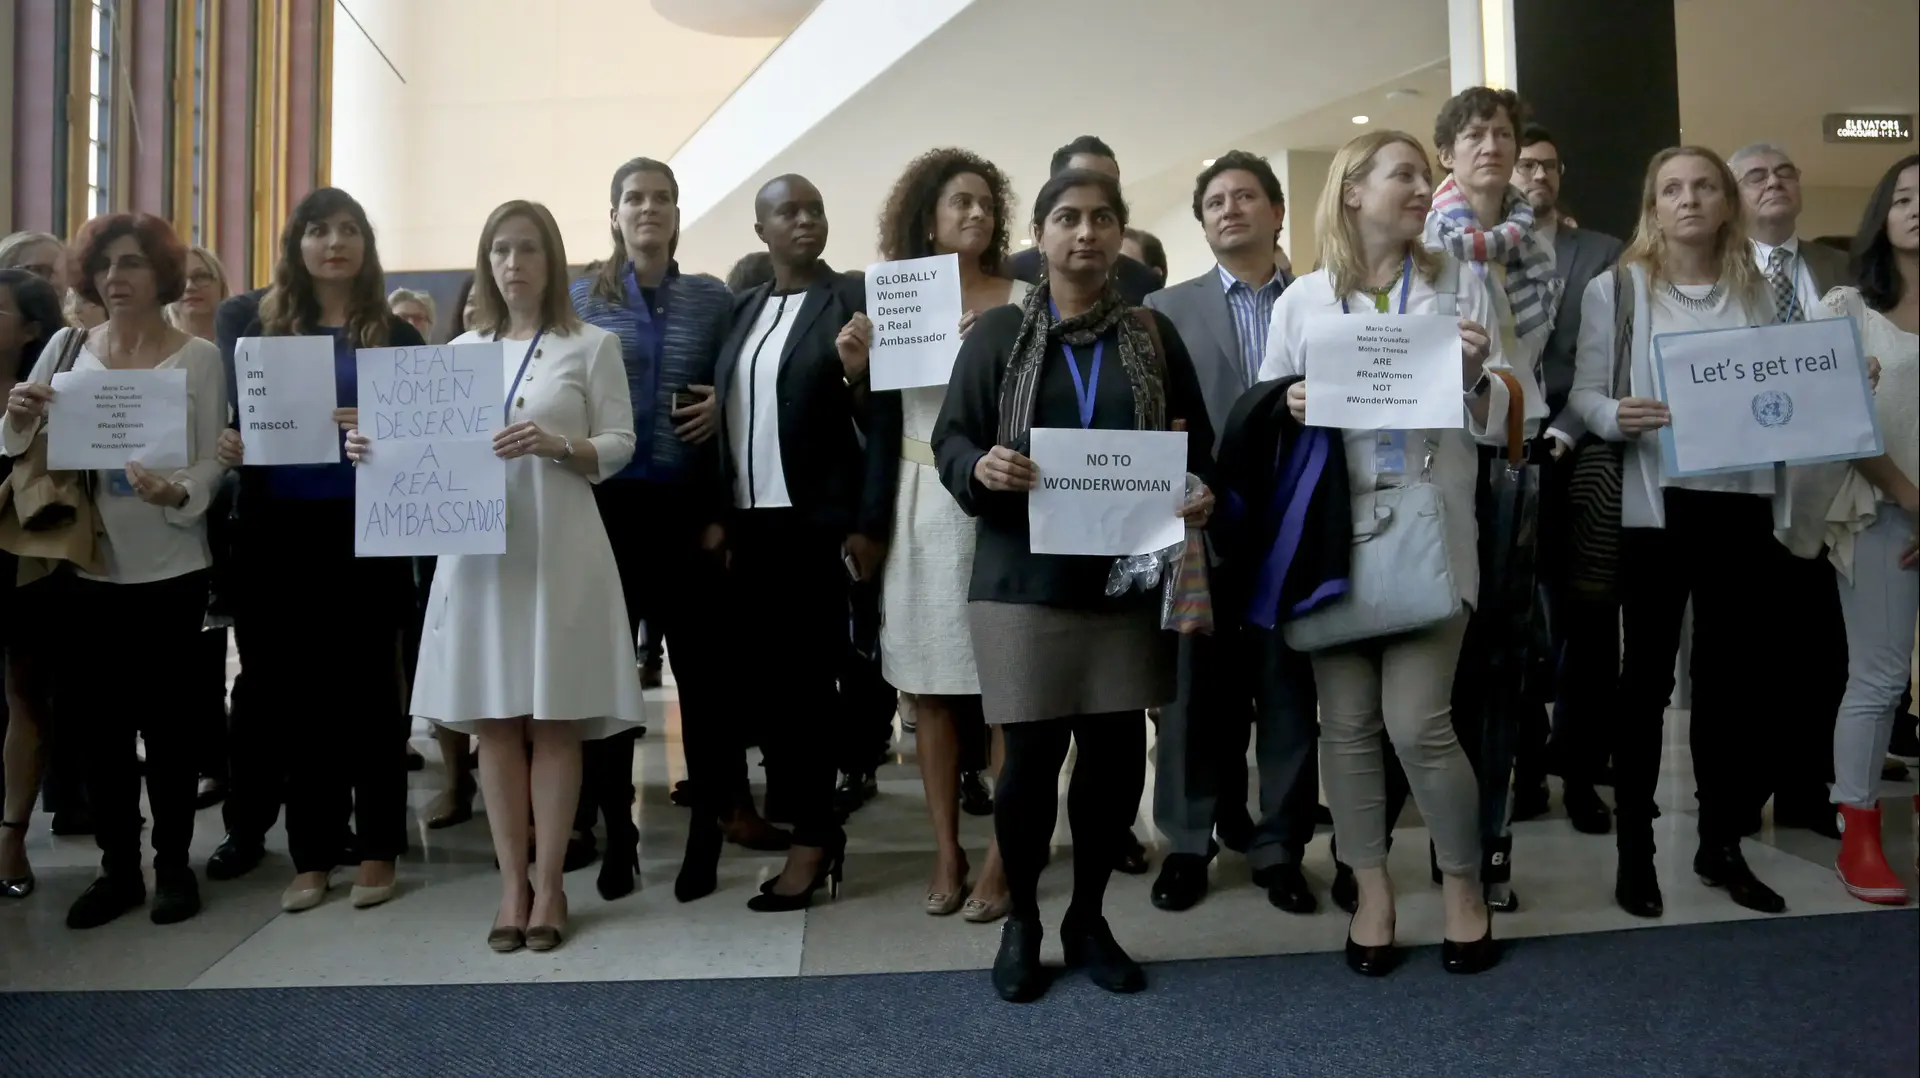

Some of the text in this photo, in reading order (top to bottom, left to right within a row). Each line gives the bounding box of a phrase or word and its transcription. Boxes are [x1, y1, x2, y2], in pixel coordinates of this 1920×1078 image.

[1845, 119, 1900, 130] ELEVATORS
[876, 270, 938, 285] GLOBALLY
[877, 290, 918, 301] Women
[878, 305, 922, 316] Deserve
[878, 320, 912, 331] a Real
[879, 332, 947, 347] Ambassador
[1356, 335, 1378, 343] Malala
[245, 351, 249, 362] I
[394, 347, 474, 376] REAL
[1372, 358, 1392, 366] ARE
[1752, 356, 1788, 382] get
[1795, 348, 1838, 373] real
[247, 369, 264, 379] am
[1356, 370, 1413, 379] #RealWomen
[248, 386, 267, 396] not
[372, 375, 474, 406] WOMEN
[1372, 384, 1392, 392] NOT
[1346, 396, 1418, 405] #WonderWoman
[248, 405, 256, 413] a
[249, 419, 298, 430] mascot.
[375, 405, 493, 440] DESERVE
[416, 443, 440, 469] A
[1087, 454, 1132, 466] NO TO
[389, 470, 468, 497] REAL
[1043, 477, 1171, 492] WONDERWOMAN
[363, 498, 505, 541] AMBASSADOR
